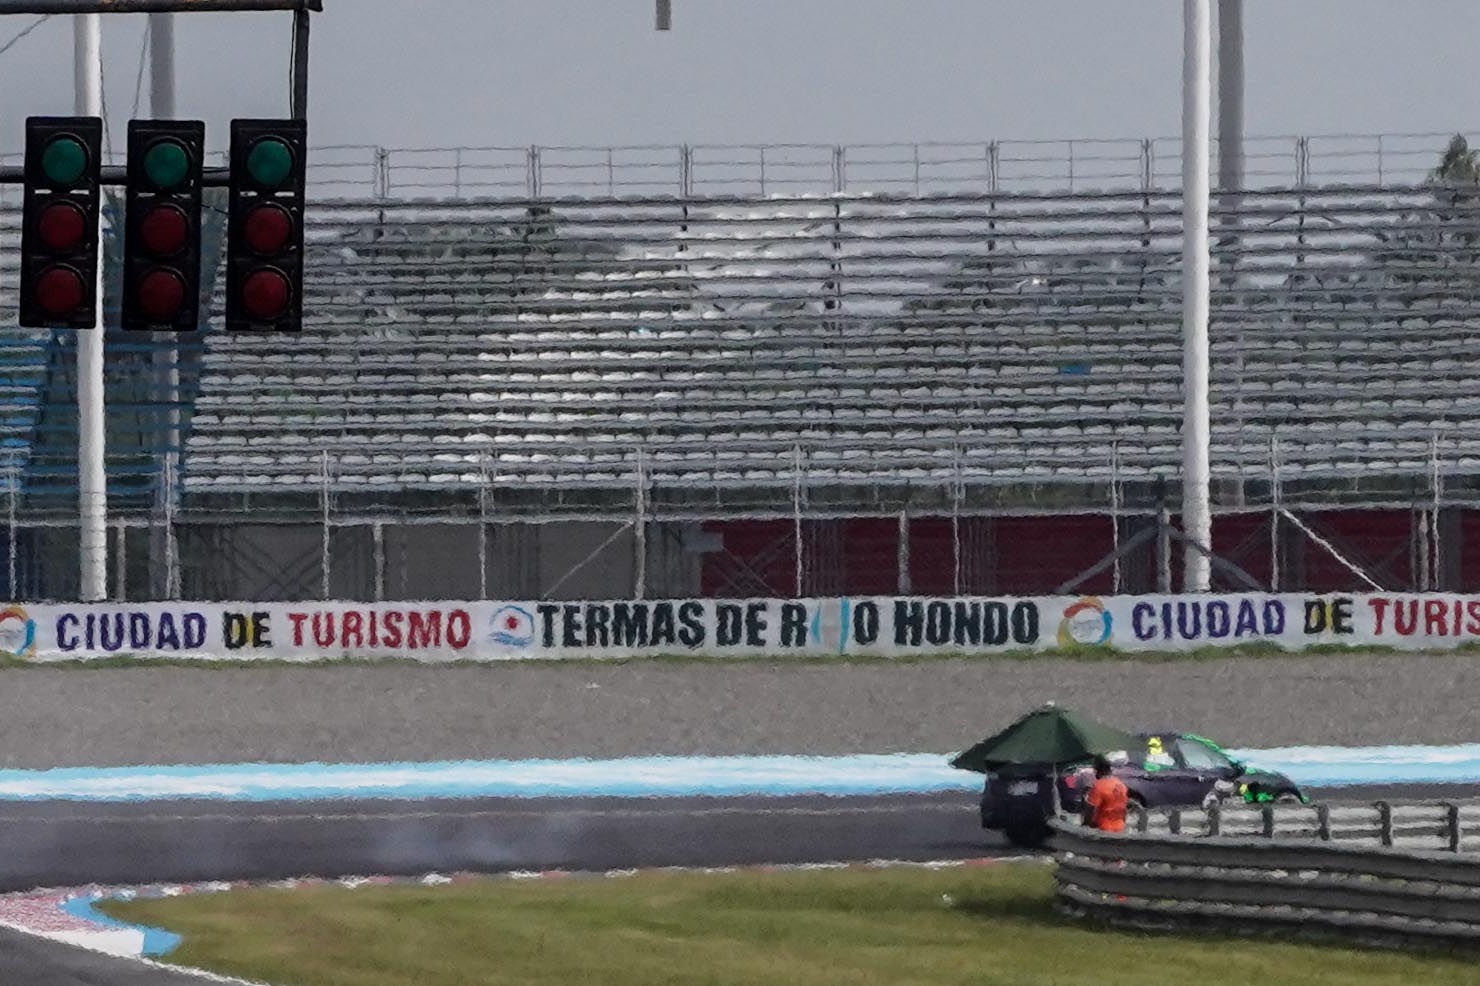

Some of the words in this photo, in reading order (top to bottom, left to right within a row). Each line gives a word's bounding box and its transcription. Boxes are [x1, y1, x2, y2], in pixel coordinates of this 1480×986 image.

[56, 612, 208, 652] CIUDAD
[222, 611, 273, 649] DE
[288, 609, 472, 650] TURISMO
[537, 602, 707, 648] TERMAS
[715, 602, 769, 647] DE
[893, 600, 1039, 646] HONDO
[1132, 600, 1286, 641] CIUDAD
[1303, 598, 1355, 636] DE
[1367, 597, 1480, 637] TURIS
